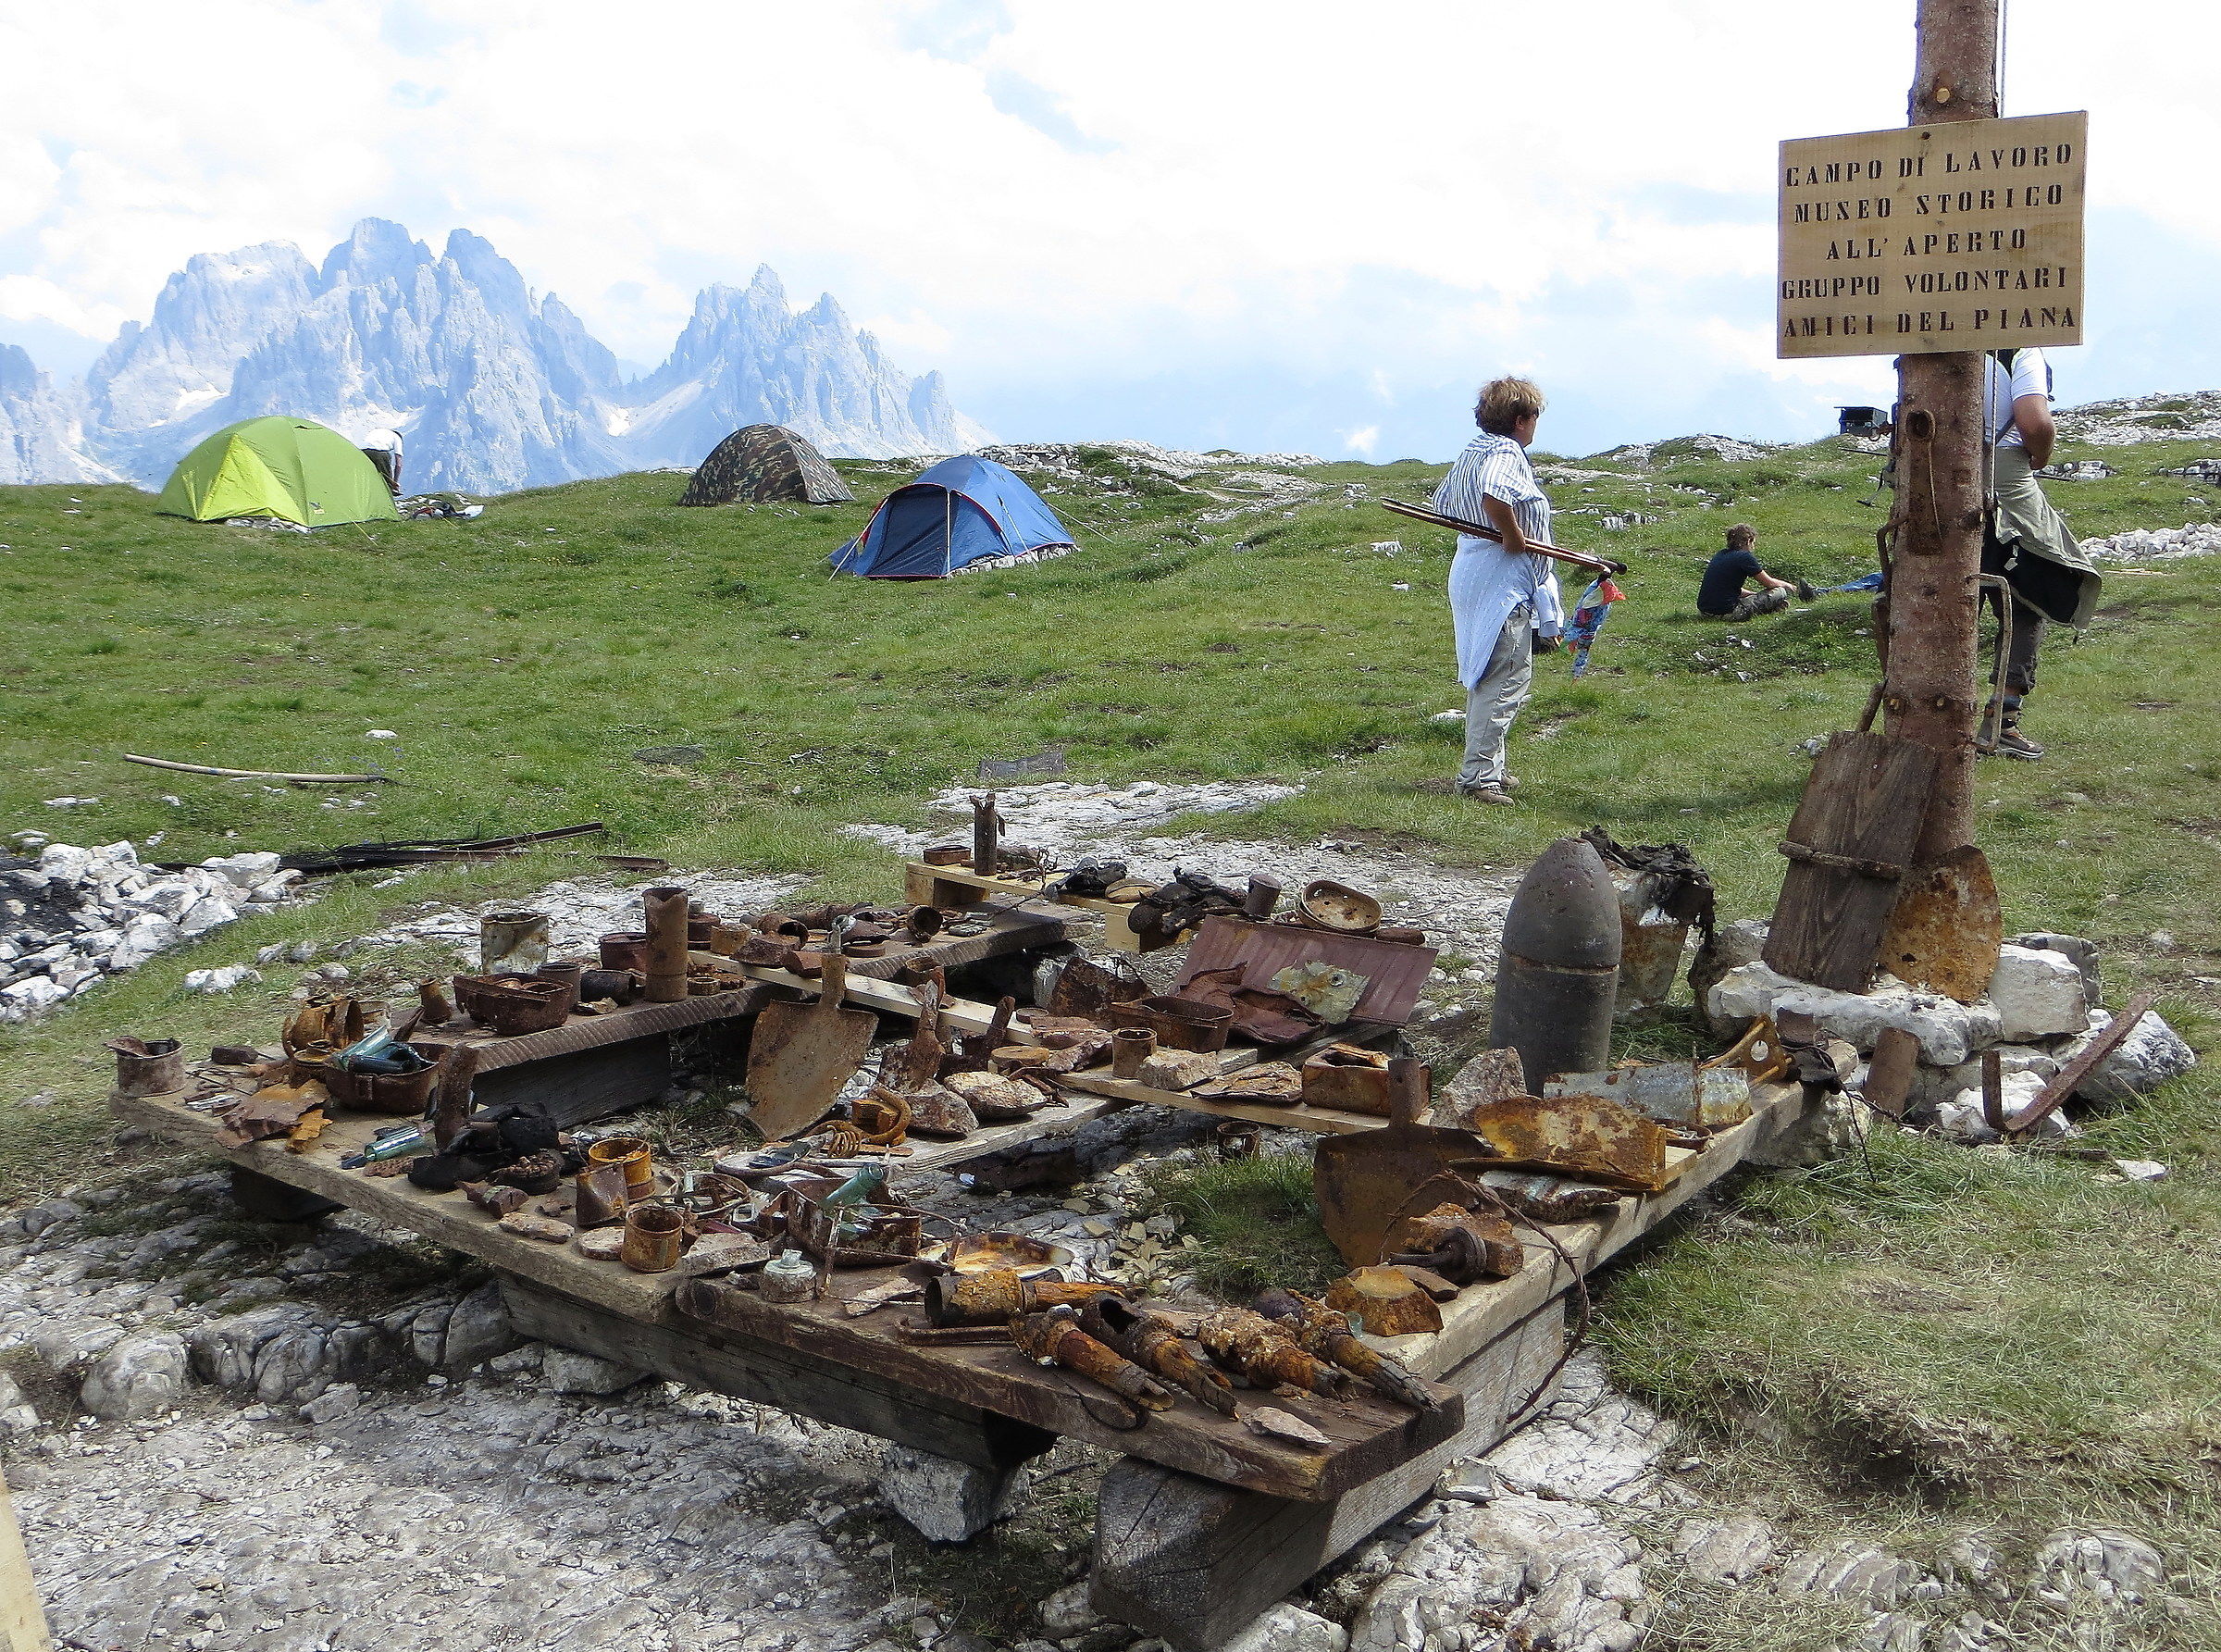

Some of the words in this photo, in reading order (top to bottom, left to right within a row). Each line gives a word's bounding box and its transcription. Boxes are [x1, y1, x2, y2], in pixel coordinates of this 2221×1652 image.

[1785, 159, 1882, 188] CAMPO
[1898, 155, 1926, 178] DI
[1945, 143, 2071, 174] LAVORO
[1794, 197, 1892, 224] MUSEO
[1916, 184, 2062, 216] STORICO
[1781, 275, 1880, 300] GRUPPO
[1904, 267, 2066, 294] VOLONTARI
[1784, 314, 1874, 338] AMICI
[1896, 310, 1954, 333] DEL
[1972, 305, 2076, 330] PIANA
